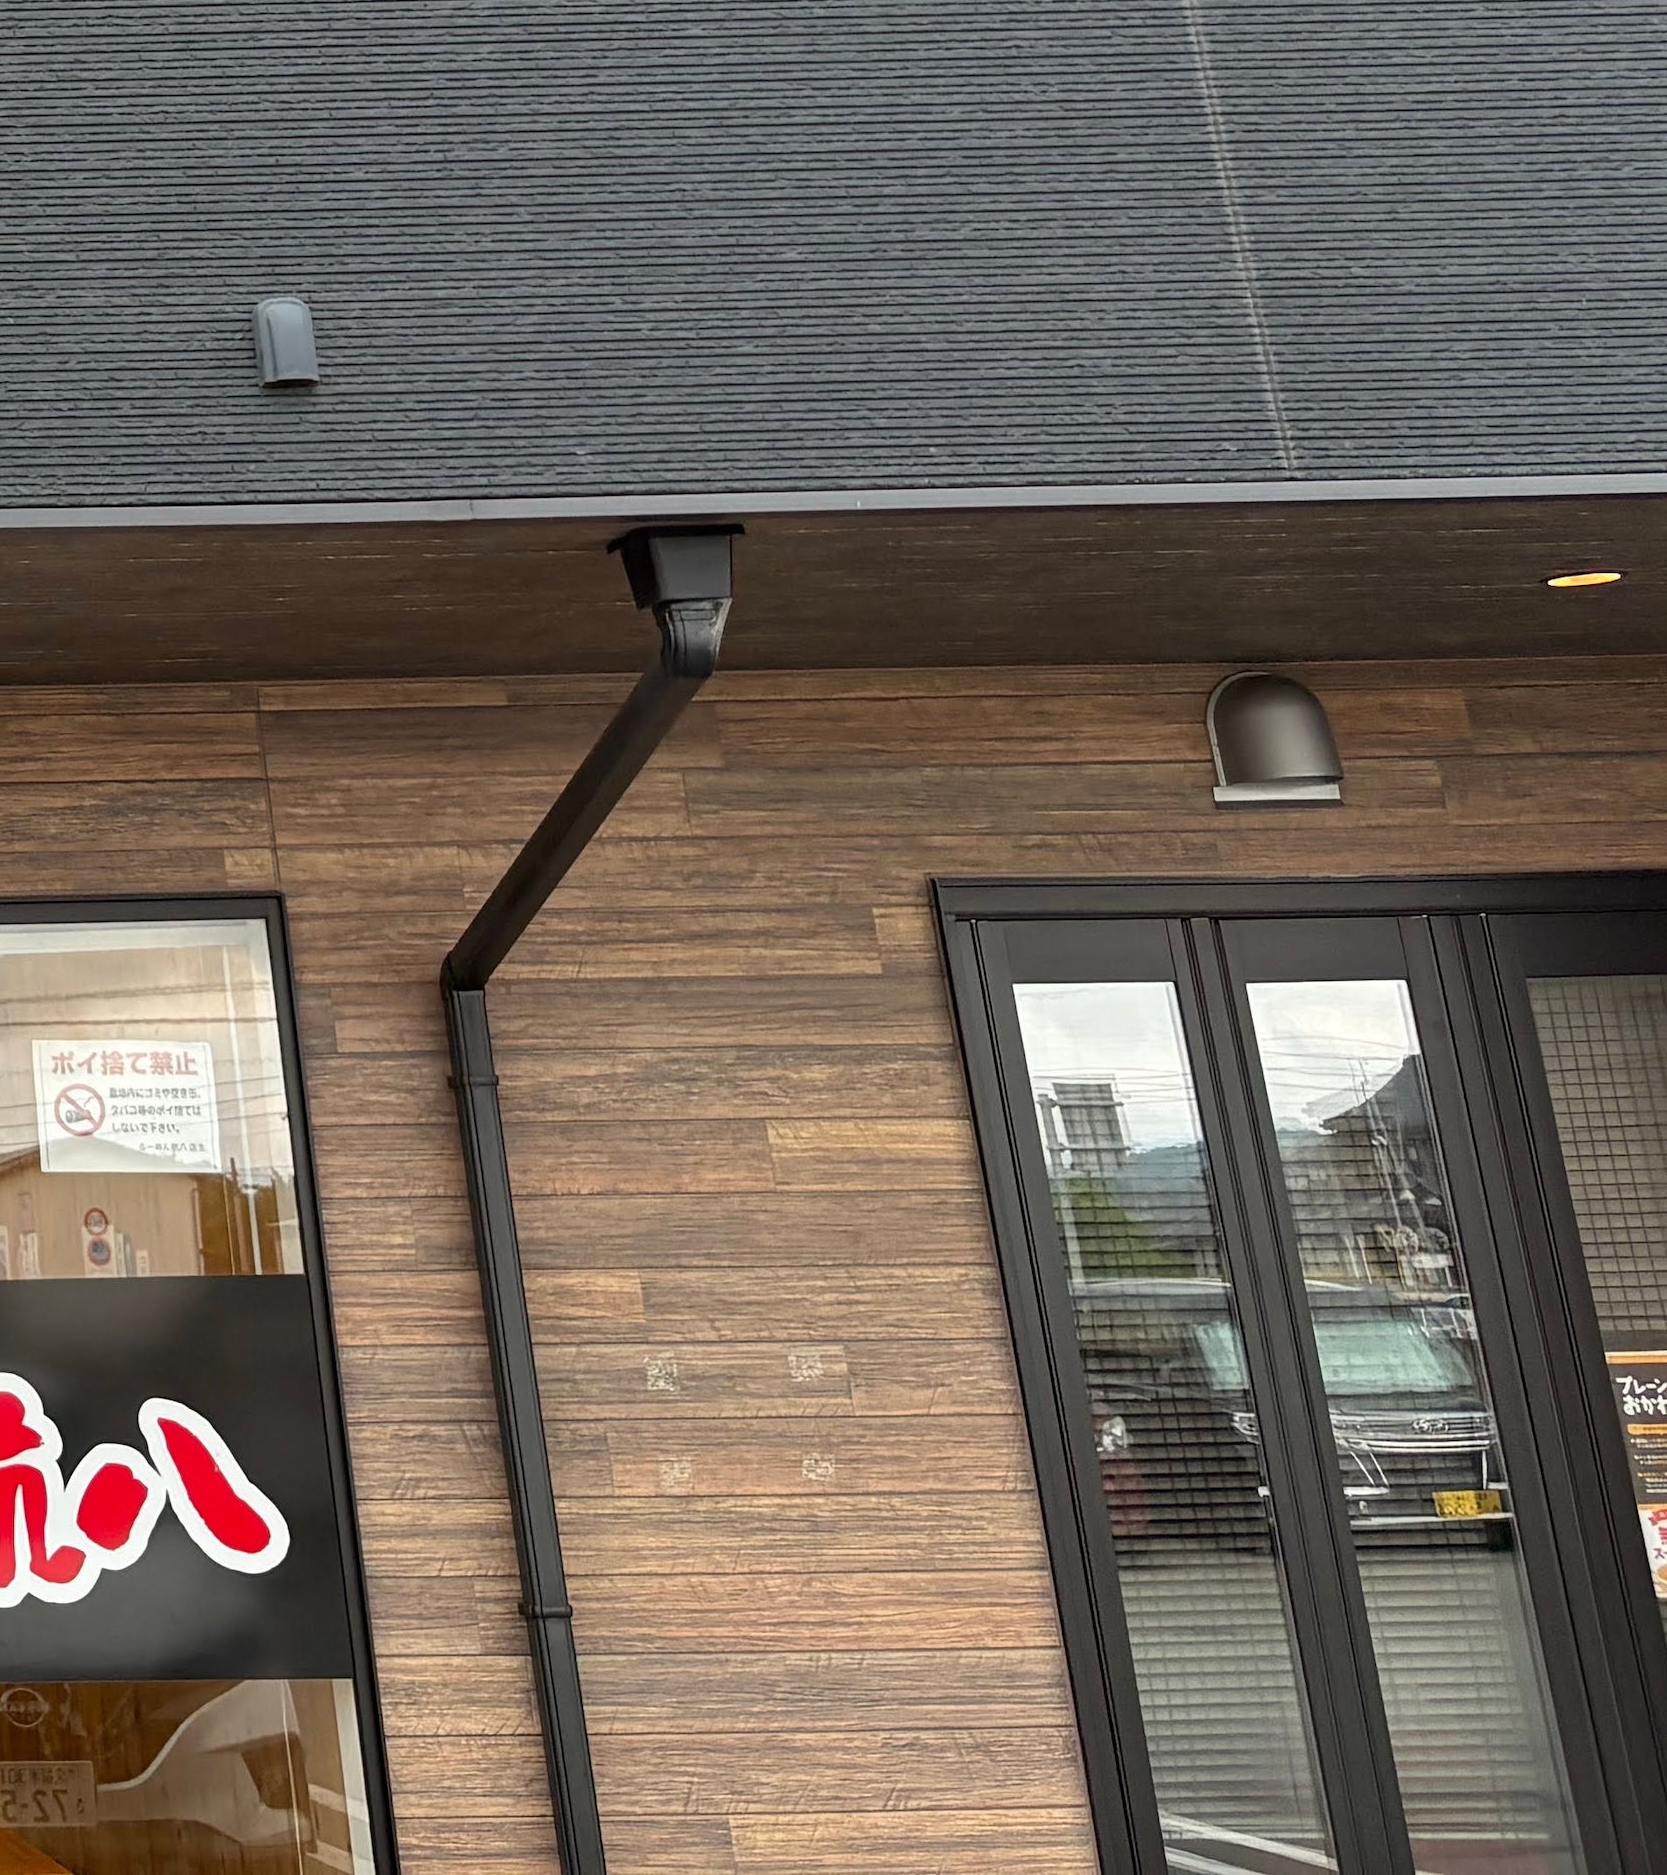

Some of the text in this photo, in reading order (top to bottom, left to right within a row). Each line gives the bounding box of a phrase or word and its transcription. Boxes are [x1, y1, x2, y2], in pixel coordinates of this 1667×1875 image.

[51, 1050, 198, 1075] ポイ捨て禁止
